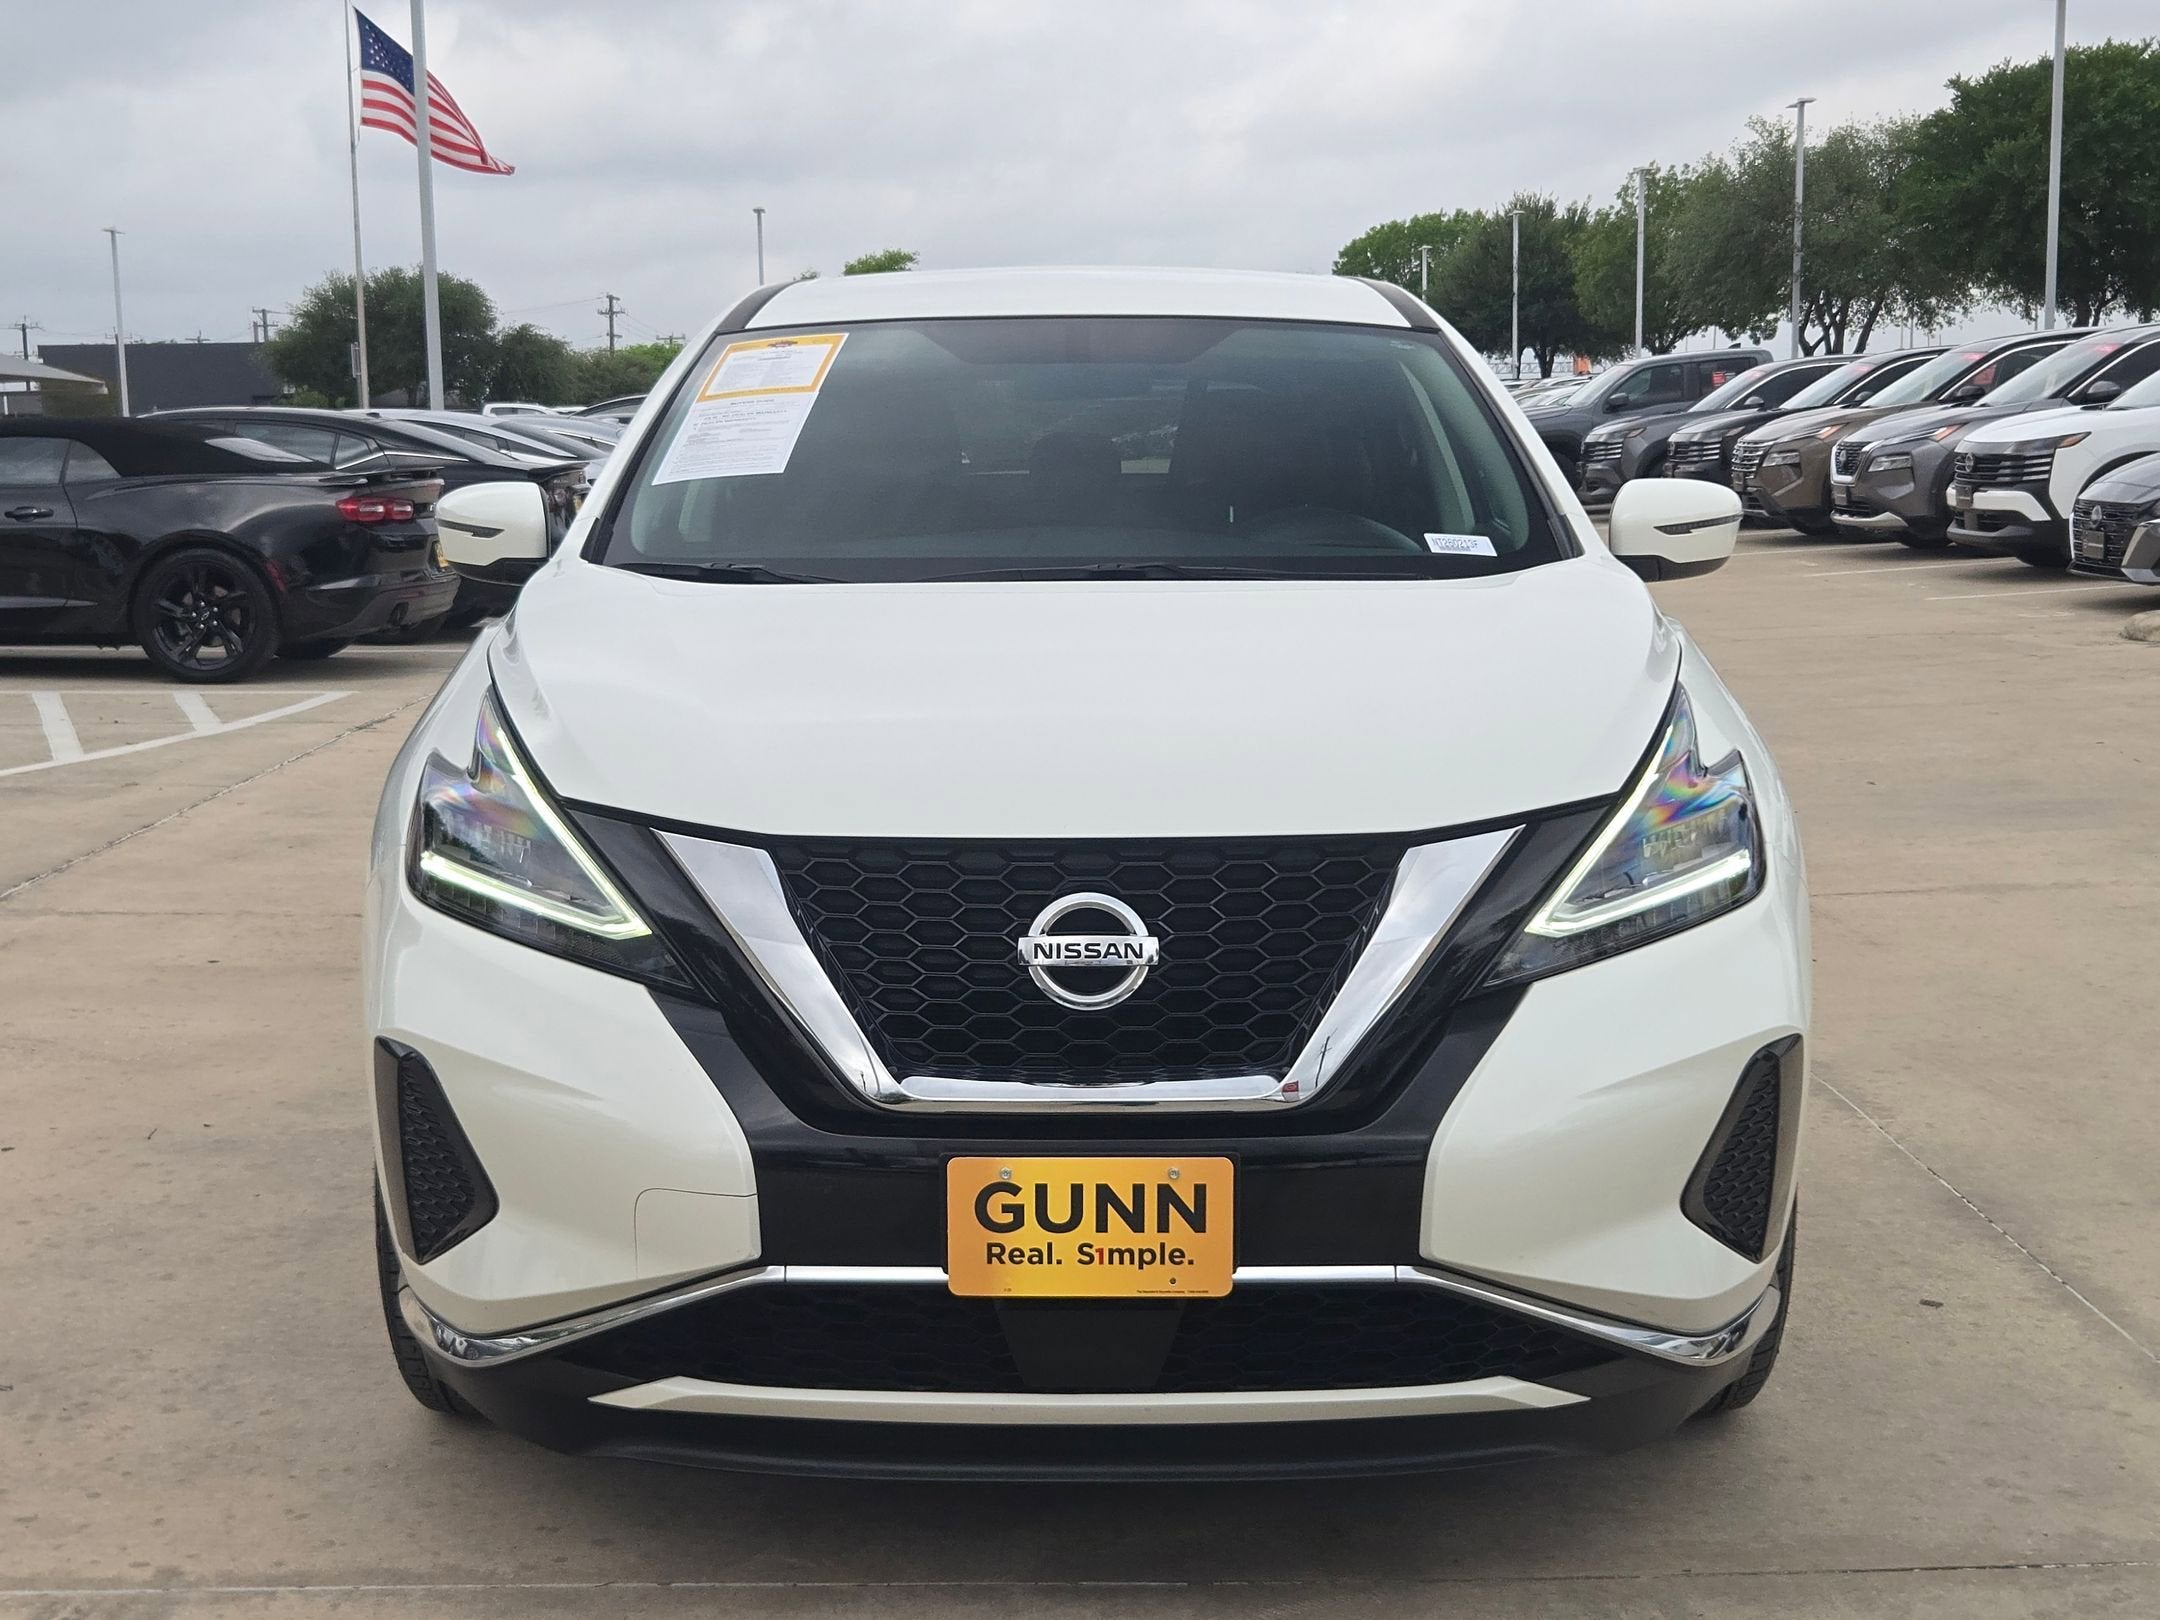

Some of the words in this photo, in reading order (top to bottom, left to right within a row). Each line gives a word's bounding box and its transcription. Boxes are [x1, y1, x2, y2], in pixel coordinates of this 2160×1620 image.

[1033, 942, 1144, 959] NISSAN
[974, 1181, 1207, 1234] GUNN
[986, 1242, 1063, 1265] Real.
[1077, 1242, 1194, 1270] S1mple.
